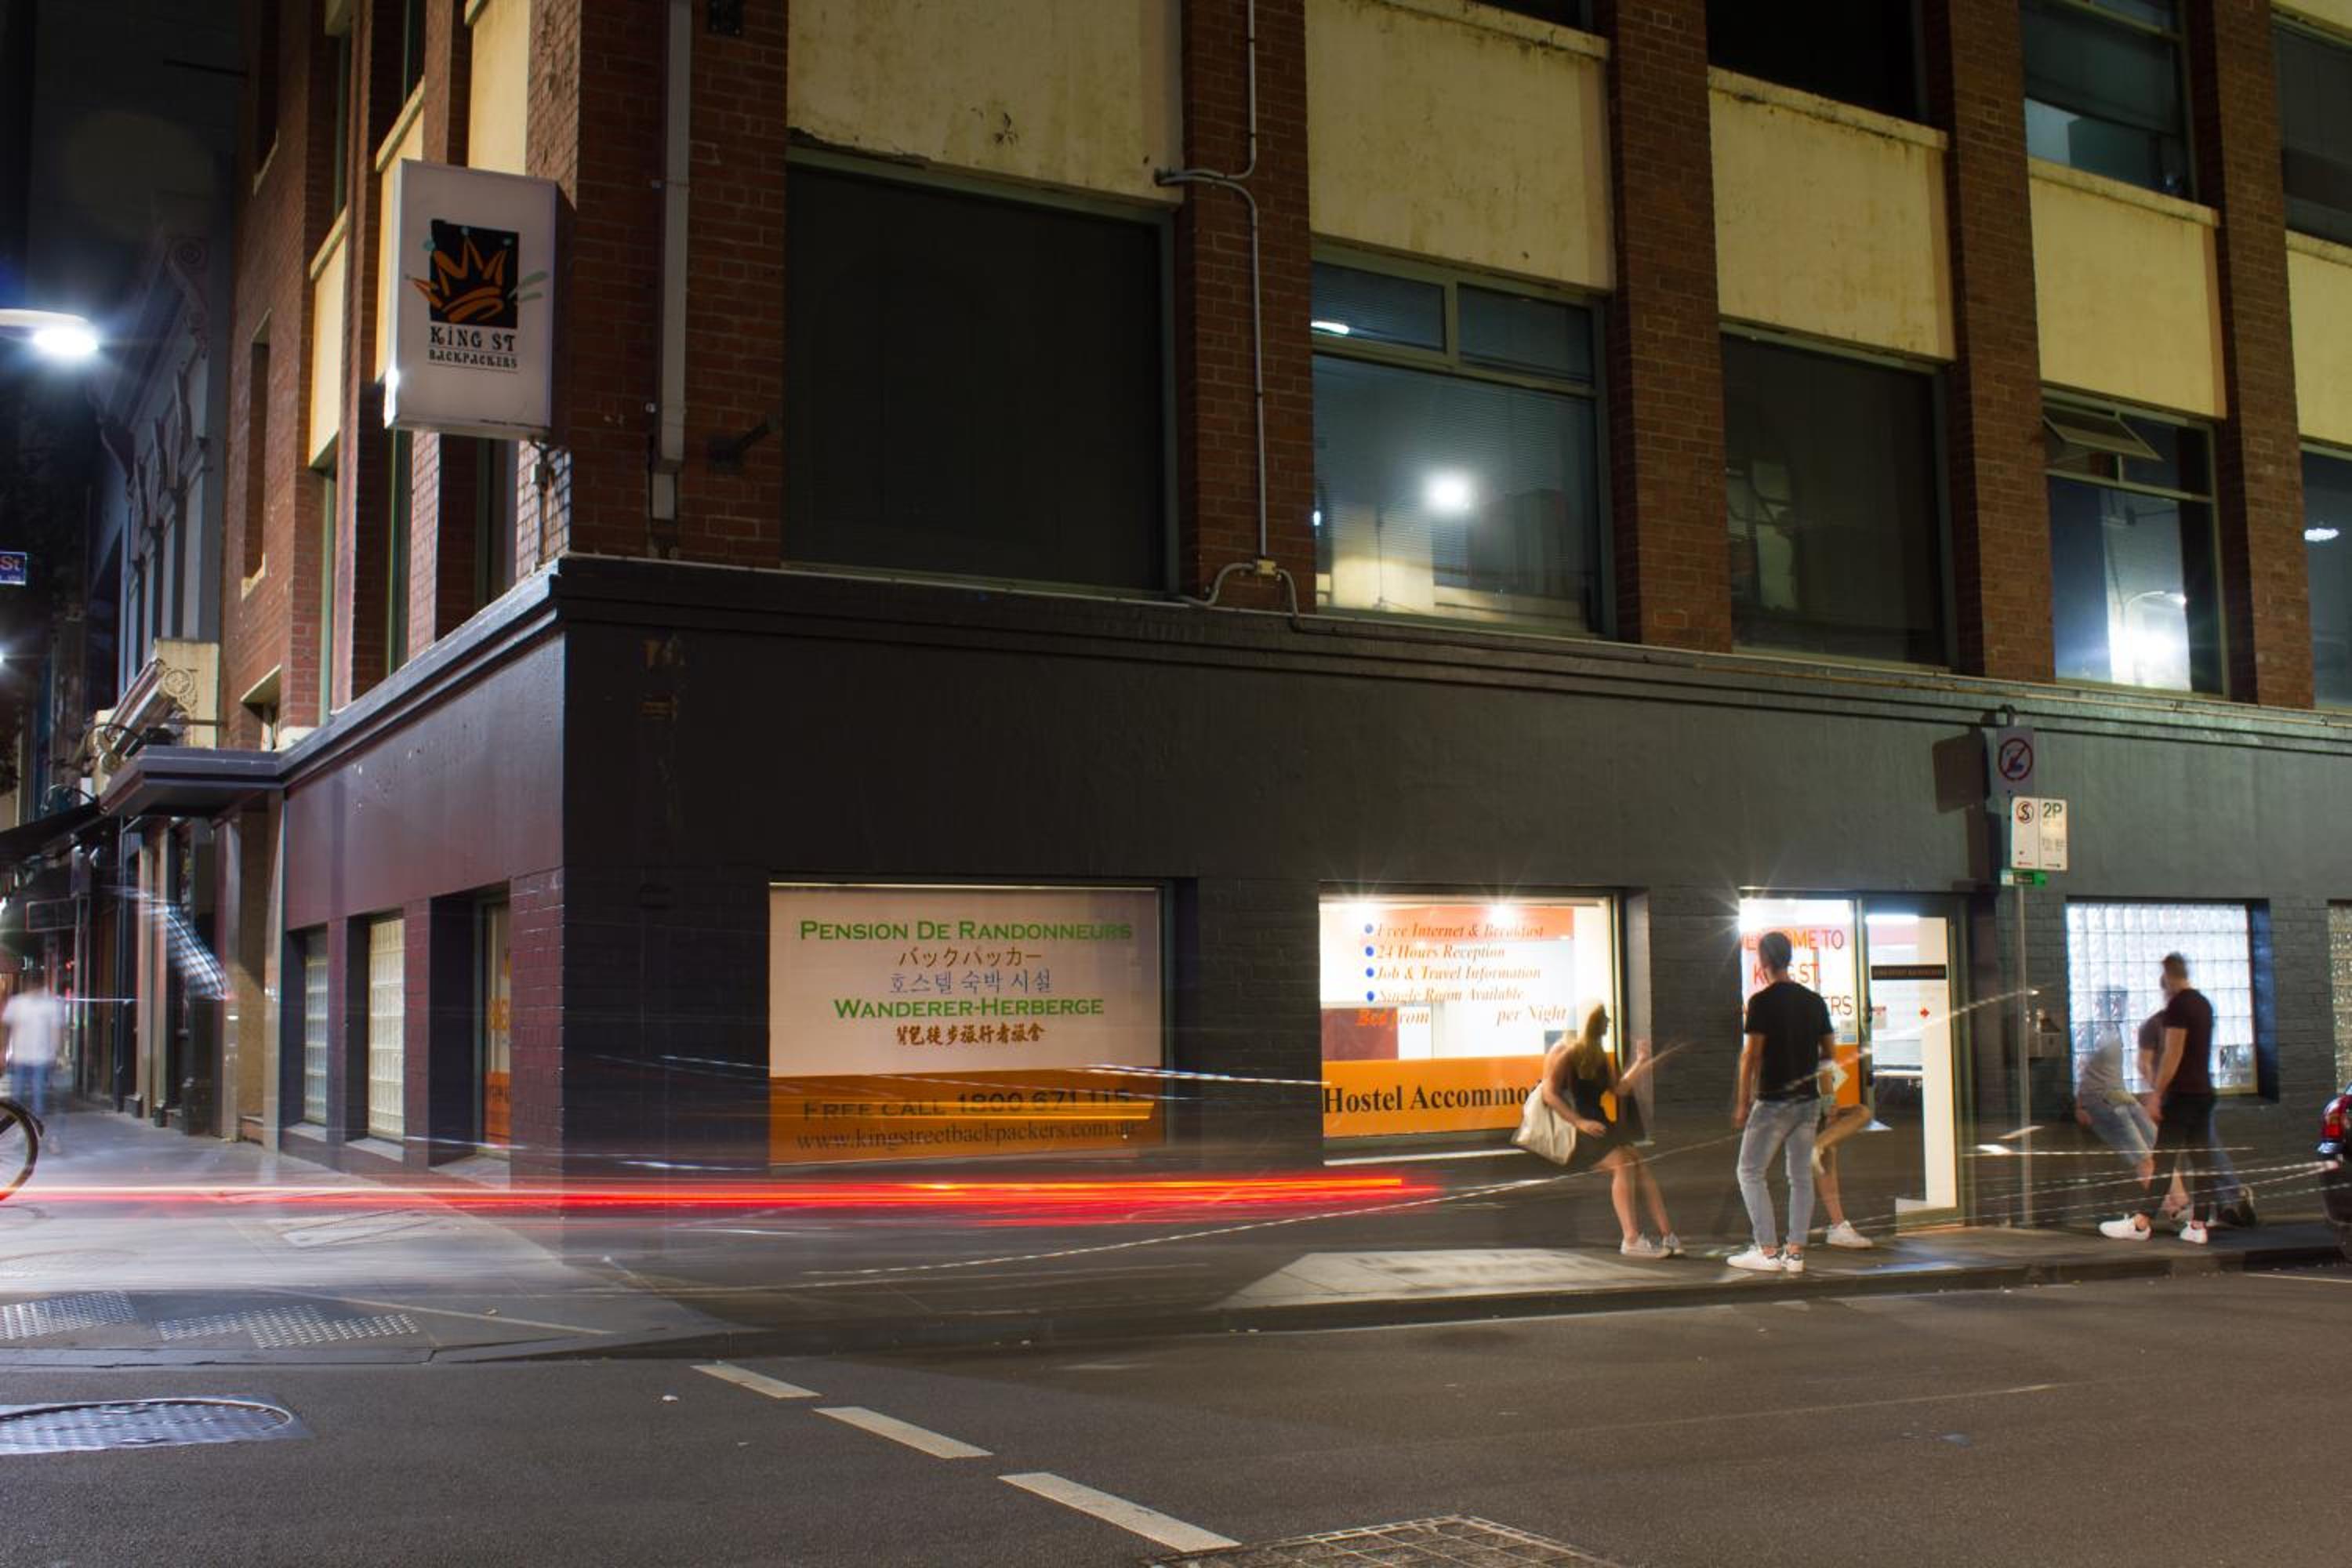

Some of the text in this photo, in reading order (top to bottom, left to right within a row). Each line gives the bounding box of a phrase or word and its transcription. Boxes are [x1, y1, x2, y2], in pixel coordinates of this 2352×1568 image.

[492, 332, 515, 352] ST
[429, 349, 517, 369] BACKPACKERS
[2042, 802, 2063, 818] 2P
[800, 920, 1132, 940] PENSION DE RANDONNEURS
[1412, 923, 1465, 938] Internet
[1468, 923, 1479, 938] &
[1377, 944, 1505, 963] 24 Hours Reception
[890, 967, 1052, 995] 호스텔 숙박 시설
[1376, 965, 1399, 980] Job
[1421, 965, 1461, 979] Travel
[1465, 965, 1541, 982] Information
[833, 996, 1105, 1019] WANDERER-HERBERGE
[804, 1100, 873, 1120] FREE
[881, 1098, 946, 1117] CALL
[1323, 1084, 1529, 1114] Hostel Accommo
